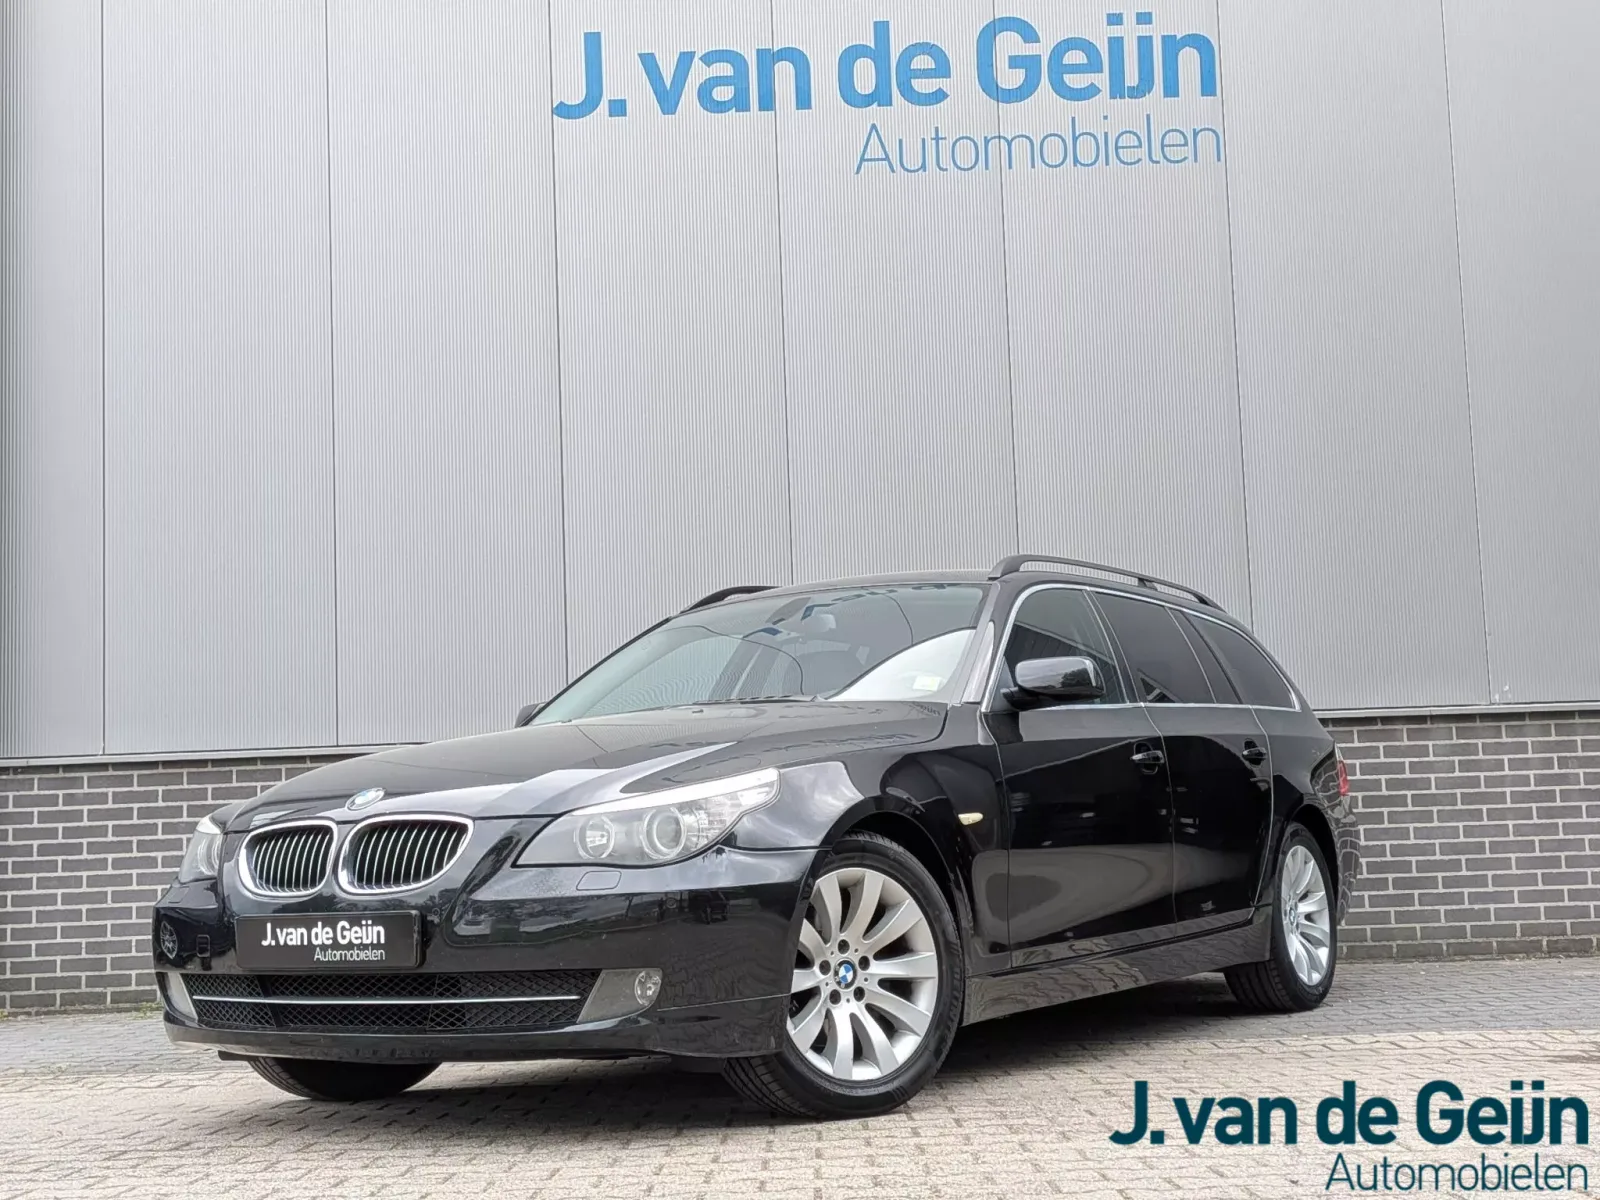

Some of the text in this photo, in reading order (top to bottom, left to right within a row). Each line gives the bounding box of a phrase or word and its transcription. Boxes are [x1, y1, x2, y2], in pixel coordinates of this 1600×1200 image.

[638, 46, 812, 116] van
[838, 20, 951, 108] de
[976, 11, 1217, 104] Geijn
[855, 113, 1222, 175] Automobielen
[311, 921, 333, 945] de
[337, 919, 386, 945] Geijn
[313, 946, 386, 962] Automobielen
